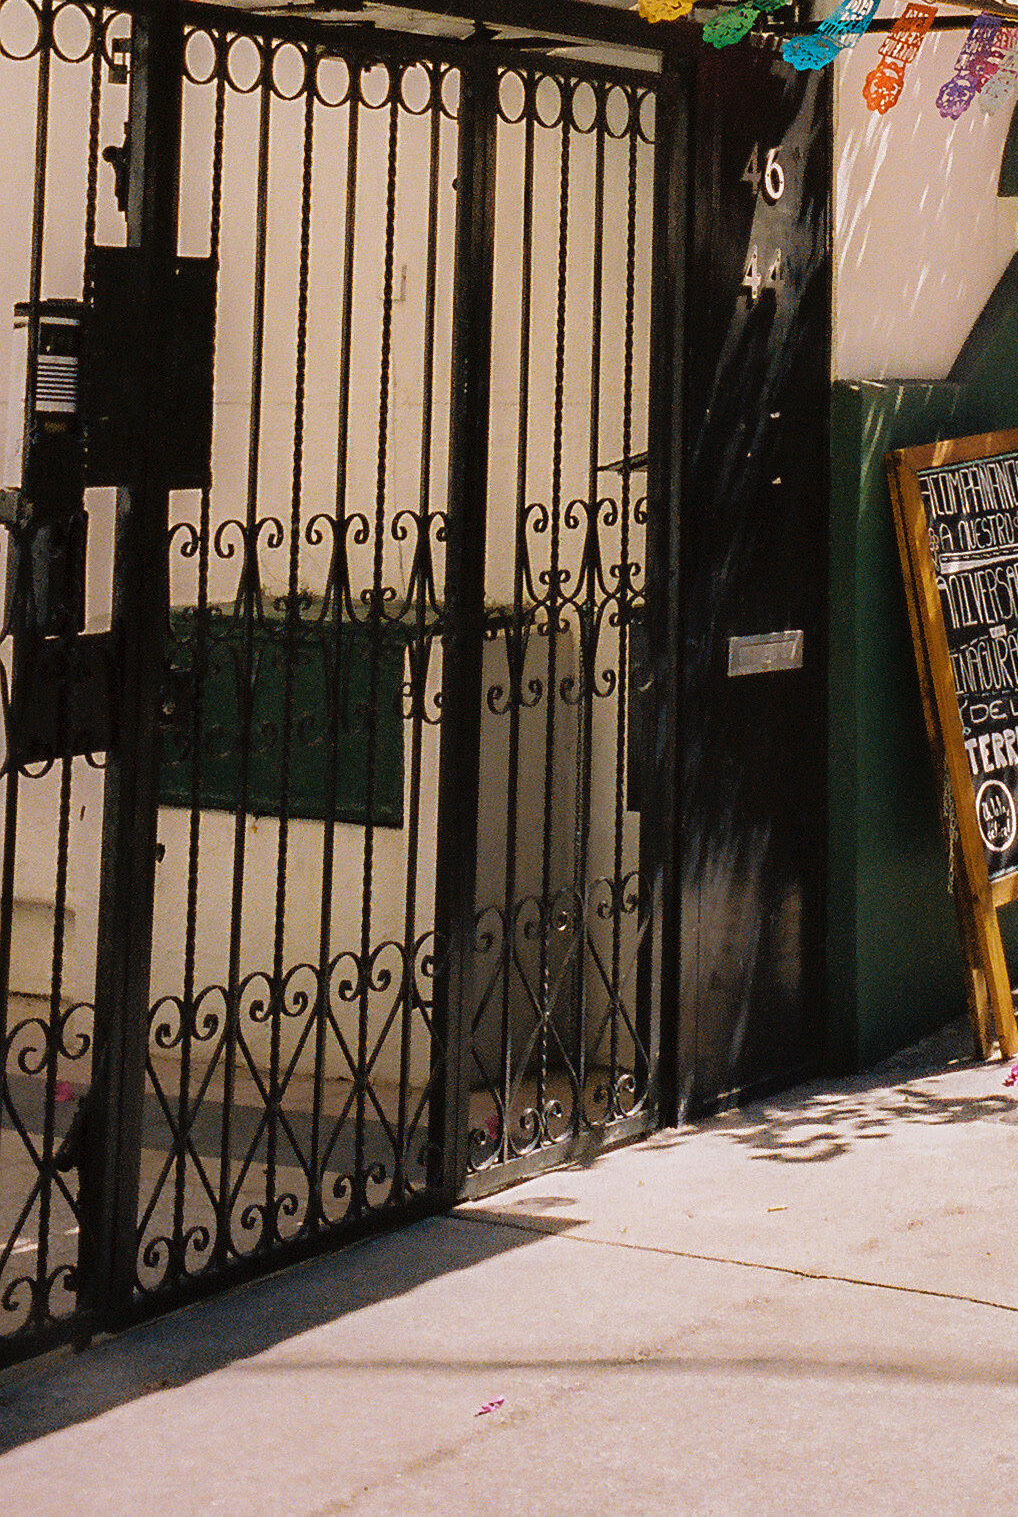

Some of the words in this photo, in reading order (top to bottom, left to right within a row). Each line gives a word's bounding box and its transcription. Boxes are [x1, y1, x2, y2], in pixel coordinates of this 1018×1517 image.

[740, 140, 785, 200] 46
[742, 243, 785, 299] 44
[939, 522, 955, 551] A
[957, 512, 1015, 551] NUESTRO
[969, 700, 1008, 723] DE
